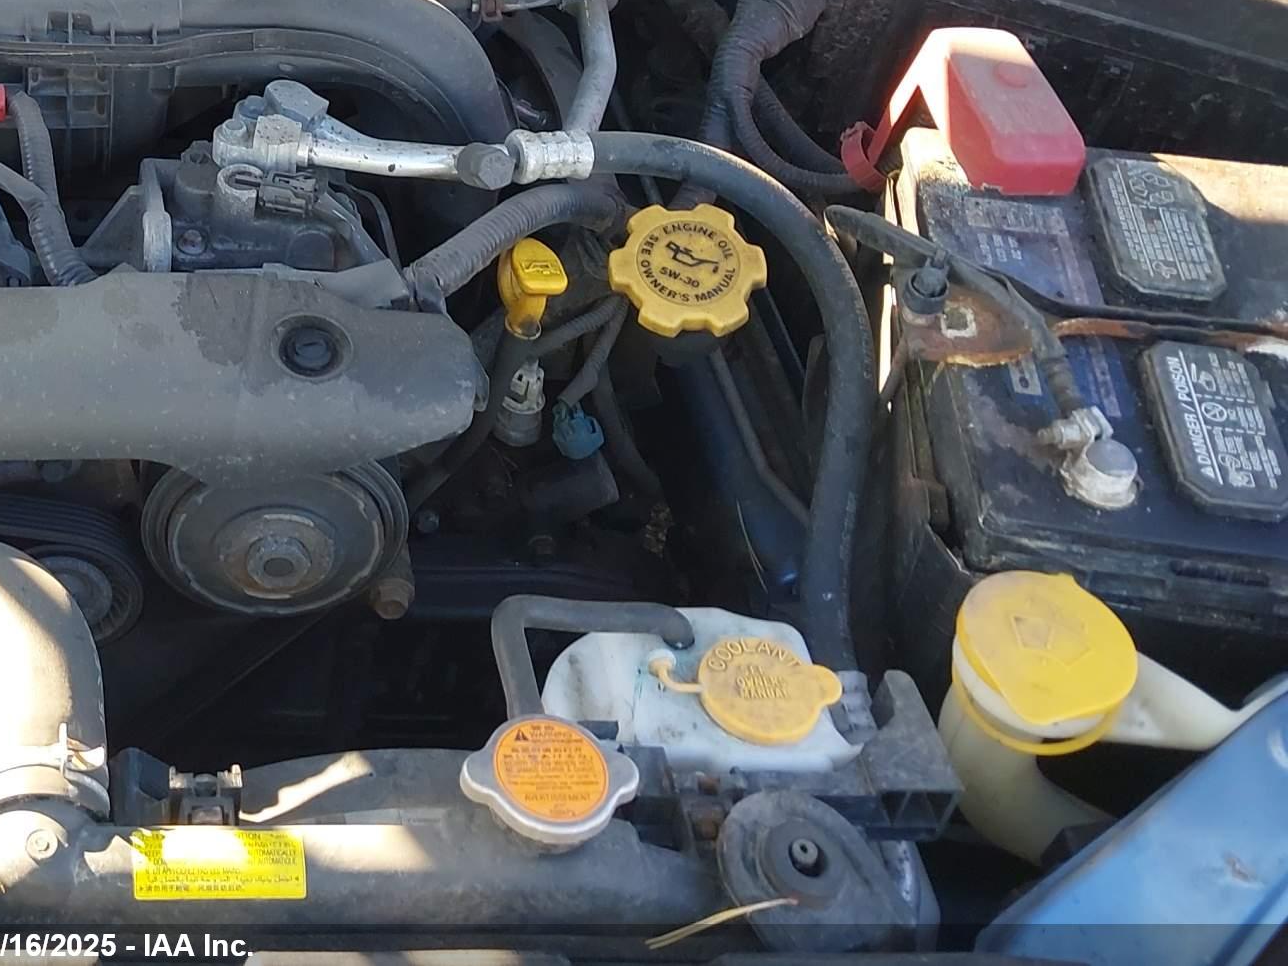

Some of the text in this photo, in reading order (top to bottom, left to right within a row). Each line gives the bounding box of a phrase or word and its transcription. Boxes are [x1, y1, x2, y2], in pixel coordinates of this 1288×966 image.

[662, 222, 733, 259] ENGINE OIL
[640, 234, 736, 302] SEE OWNER'S MANUAL
[659, 266, 701, 288] 5W-30
[1166, 356, 1193, 402] POISON
[1184, 412, 1212, 465] DANGER
[707, 637, 802, 671] COOLANT
